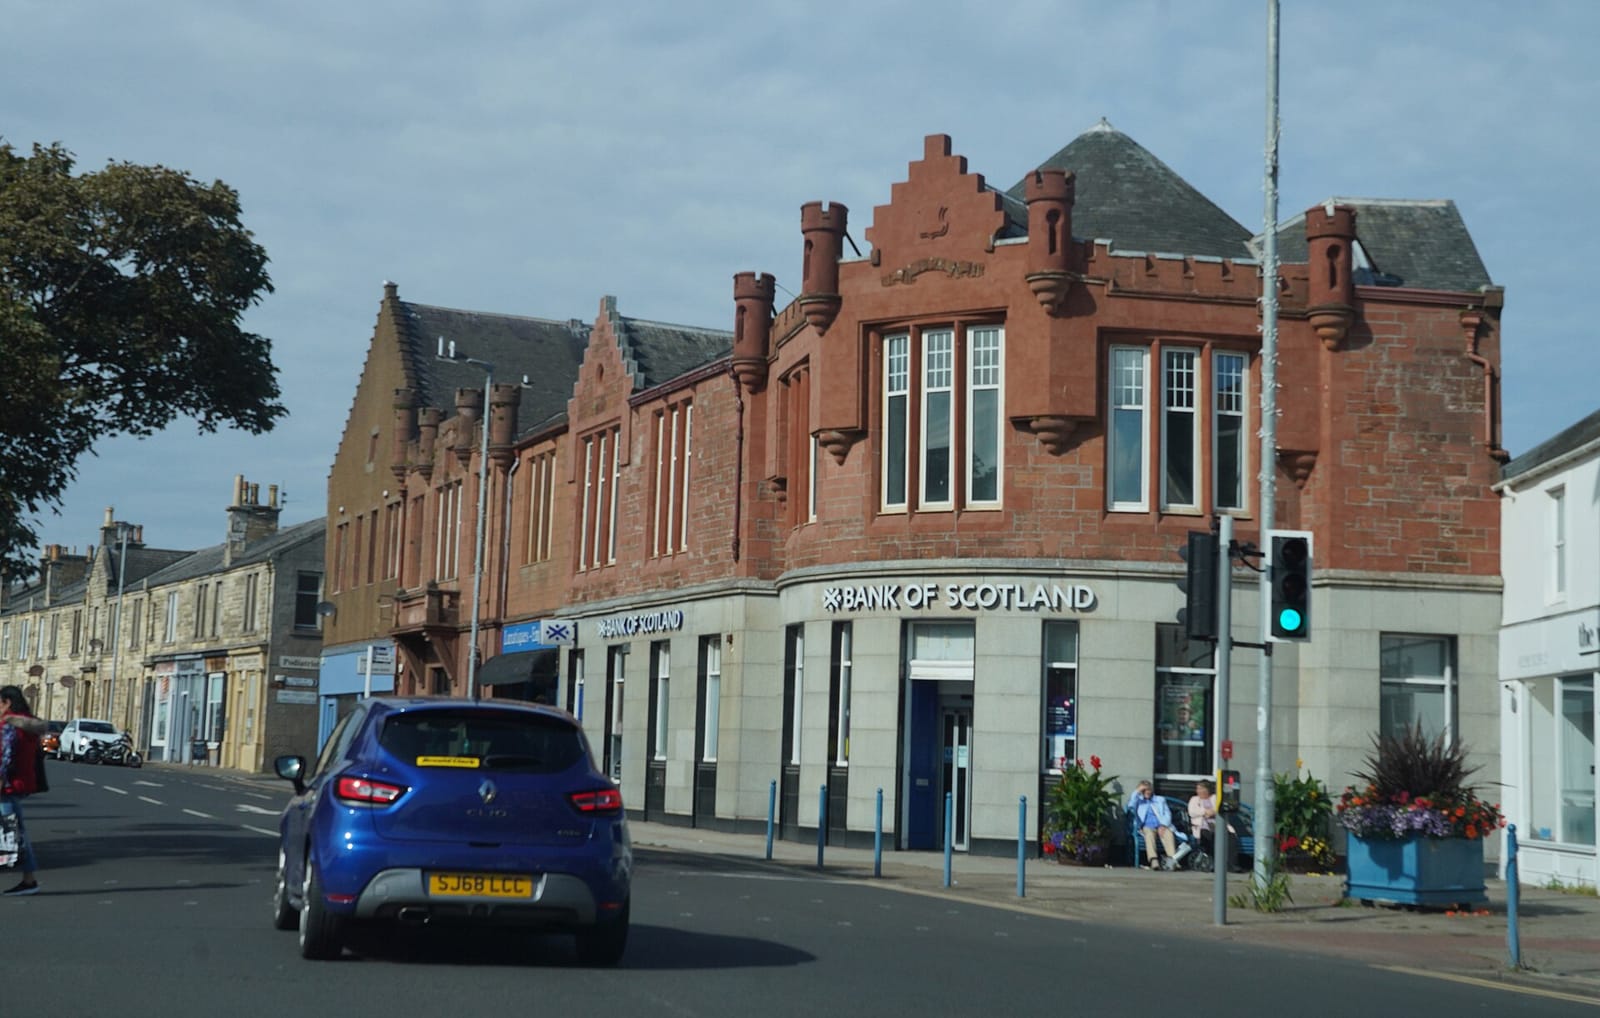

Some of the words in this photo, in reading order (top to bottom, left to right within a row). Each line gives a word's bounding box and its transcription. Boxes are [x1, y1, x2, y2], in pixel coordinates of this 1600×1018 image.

[844, 584, 900, 611] BANK
[903, 583, 939, 608] OF
[945, 582, 1097, 611] SCOTLAND
[605, 617, 627, 637] BANK
[626, 615, 639, 634] OF
[639, 610, 682, 633] SCOTLAND
[437, 875, 485, 892] SJ68
[489, 877, 524, 893] LCC
